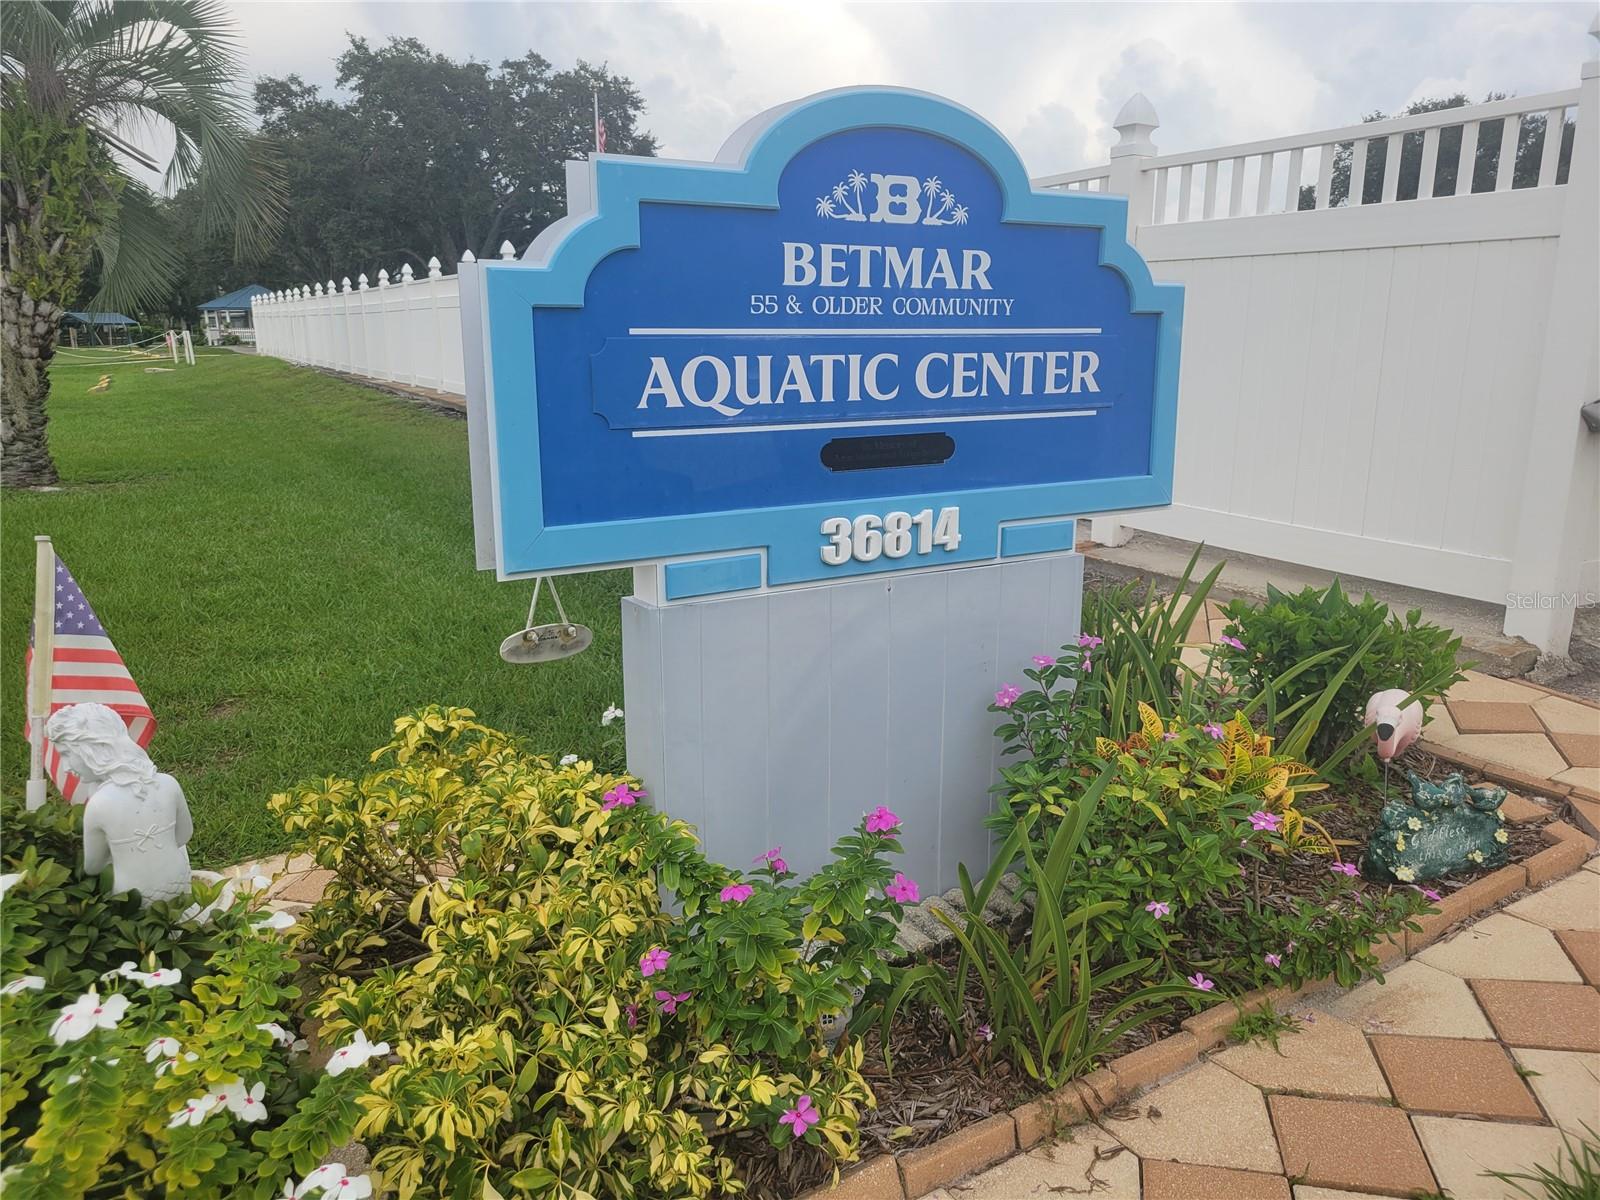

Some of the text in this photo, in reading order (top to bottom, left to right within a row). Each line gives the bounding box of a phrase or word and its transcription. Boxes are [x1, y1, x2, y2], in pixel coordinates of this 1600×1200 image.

[869, 173, 922, 225] B
[782, 242, 992, 290] BETMAR
[750, 295, 1014, 316] 55 & OLDER COMMUNITY
[637, 351, 1100, 417] AQUATIC CENTER
[820, 506, 962, 567] 36814
